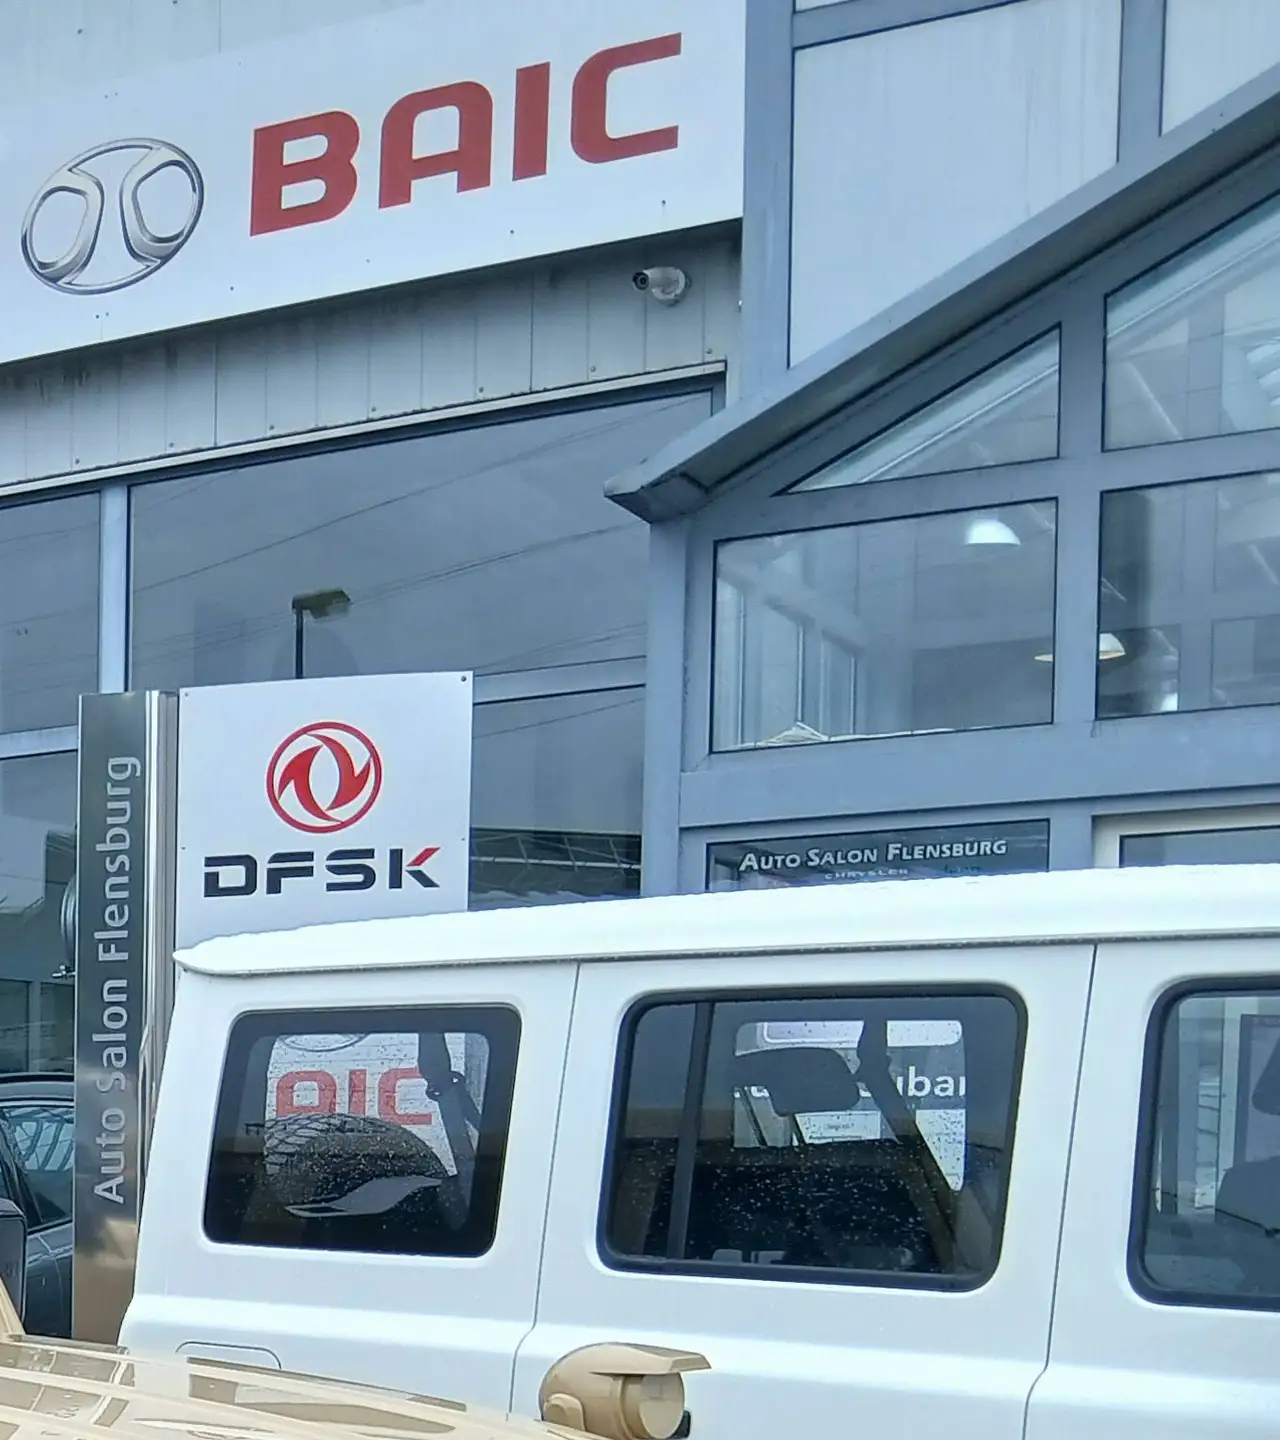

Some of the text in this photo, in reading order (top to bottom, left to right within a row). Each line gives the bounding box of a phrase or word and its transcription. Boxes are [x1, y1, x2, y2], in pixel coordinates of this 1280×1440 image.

[250, 32, 682, 236] BAIC
[204, 846, 441, 898] DFSK
[91, 756, 142, 1205] Auto Salon Flensburg
